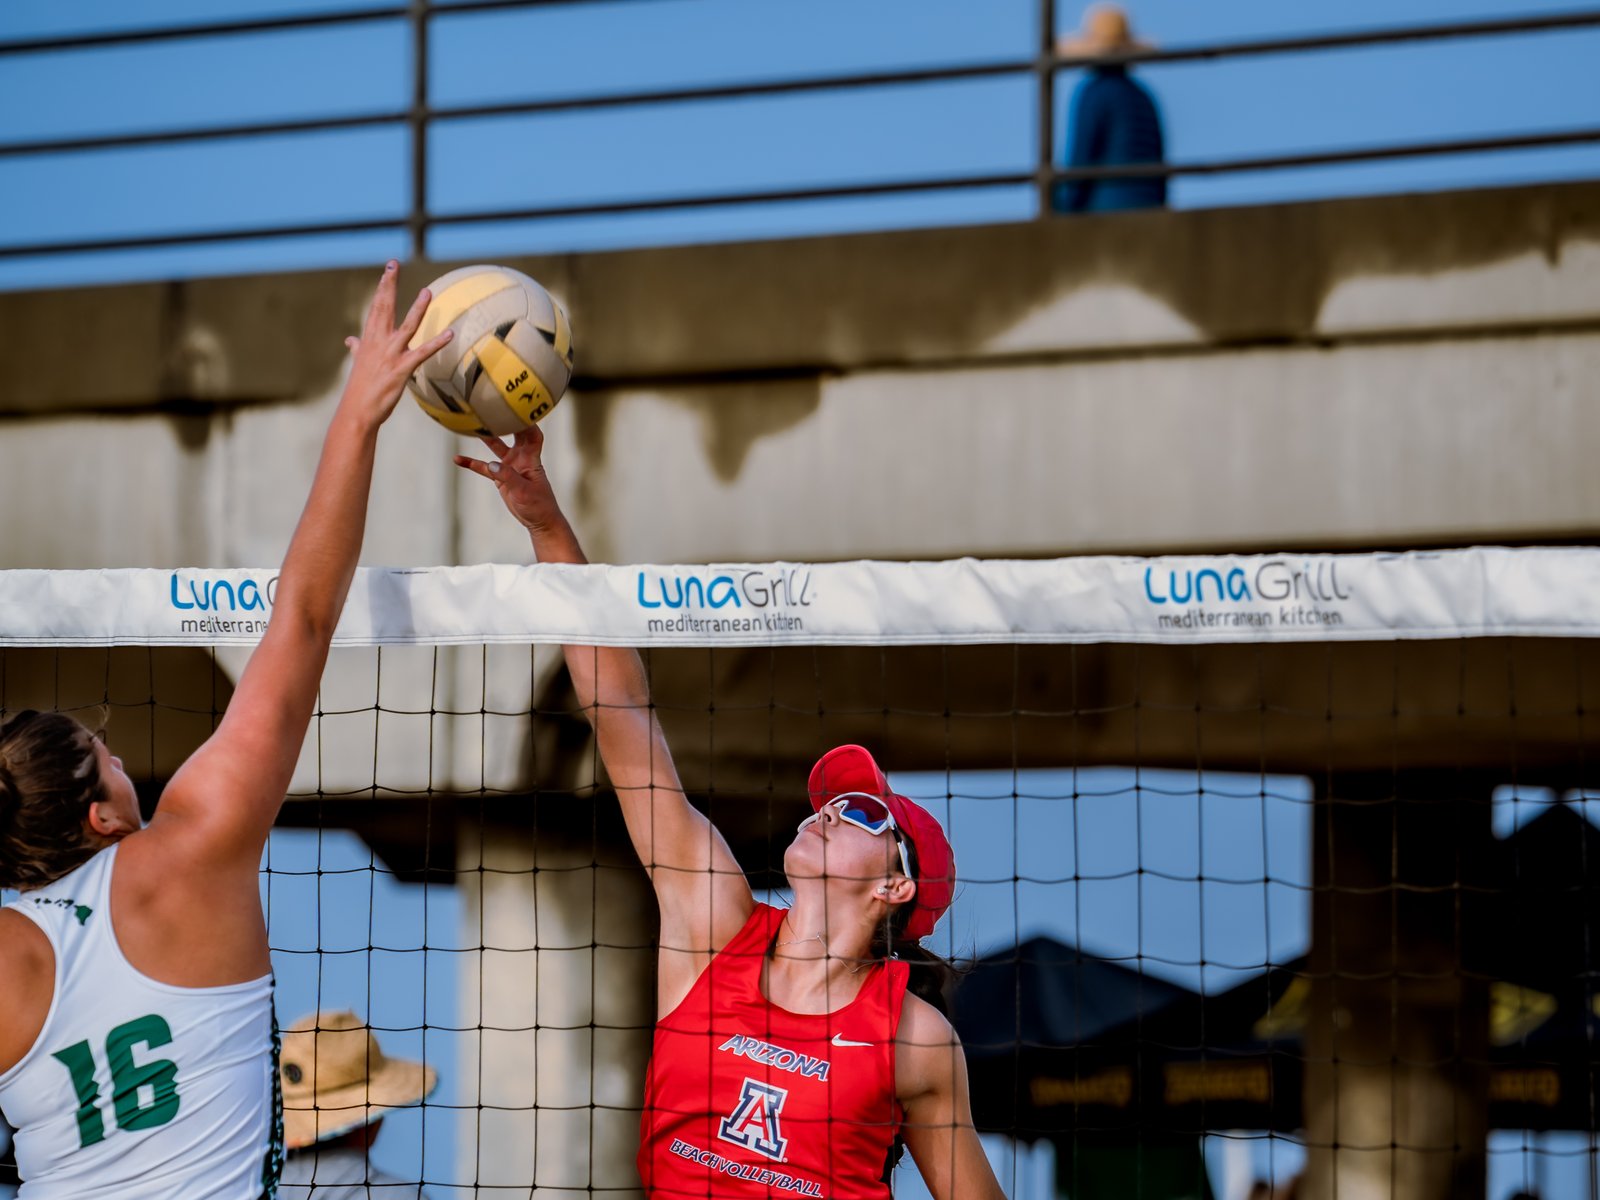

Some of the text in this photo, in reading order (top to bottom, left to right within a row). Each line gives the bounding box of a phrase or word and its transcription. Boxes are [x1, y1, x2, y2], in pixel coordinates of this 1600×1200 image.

[181, 616, 269, 633] mediterrane
[648, 614, 762, 632] mediterranean
[1158, 605, 1343, 629] mediterranean kitchen
[718, 1034, 831, 1081] ARIZONA
[51, 1013, 181, 1149] 16
[717, 1077, 788, 1162] A
